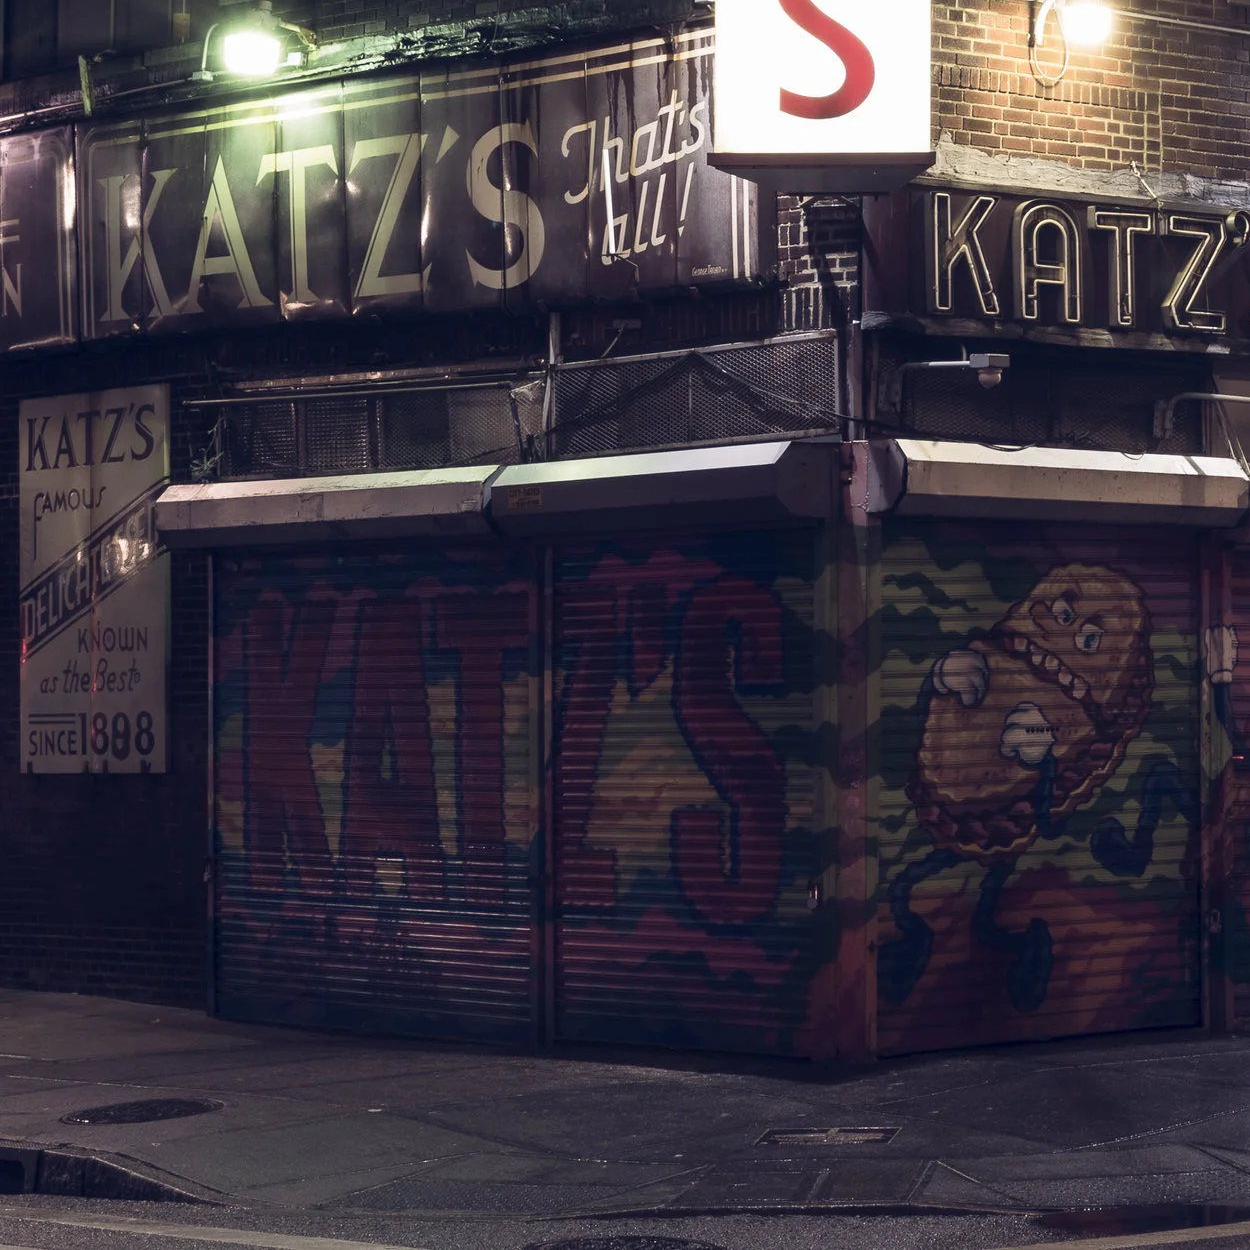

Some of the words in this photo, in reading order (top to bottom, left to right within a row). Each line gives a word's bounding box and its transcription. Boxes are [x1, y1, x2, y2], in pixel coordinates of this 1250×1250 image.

[561, 90, 706, 205] That's
[98, 121, 547, 323] KATZ'S
[25, 403, 156, 472] KATZ'S
[77, 622, 150, 654] KNOWN
[40, 675, 59, 695] as
[62, 659, 91, 695] the
[92, 658, 138, 693] Best
[28, 729, 78, 757] SINCE
